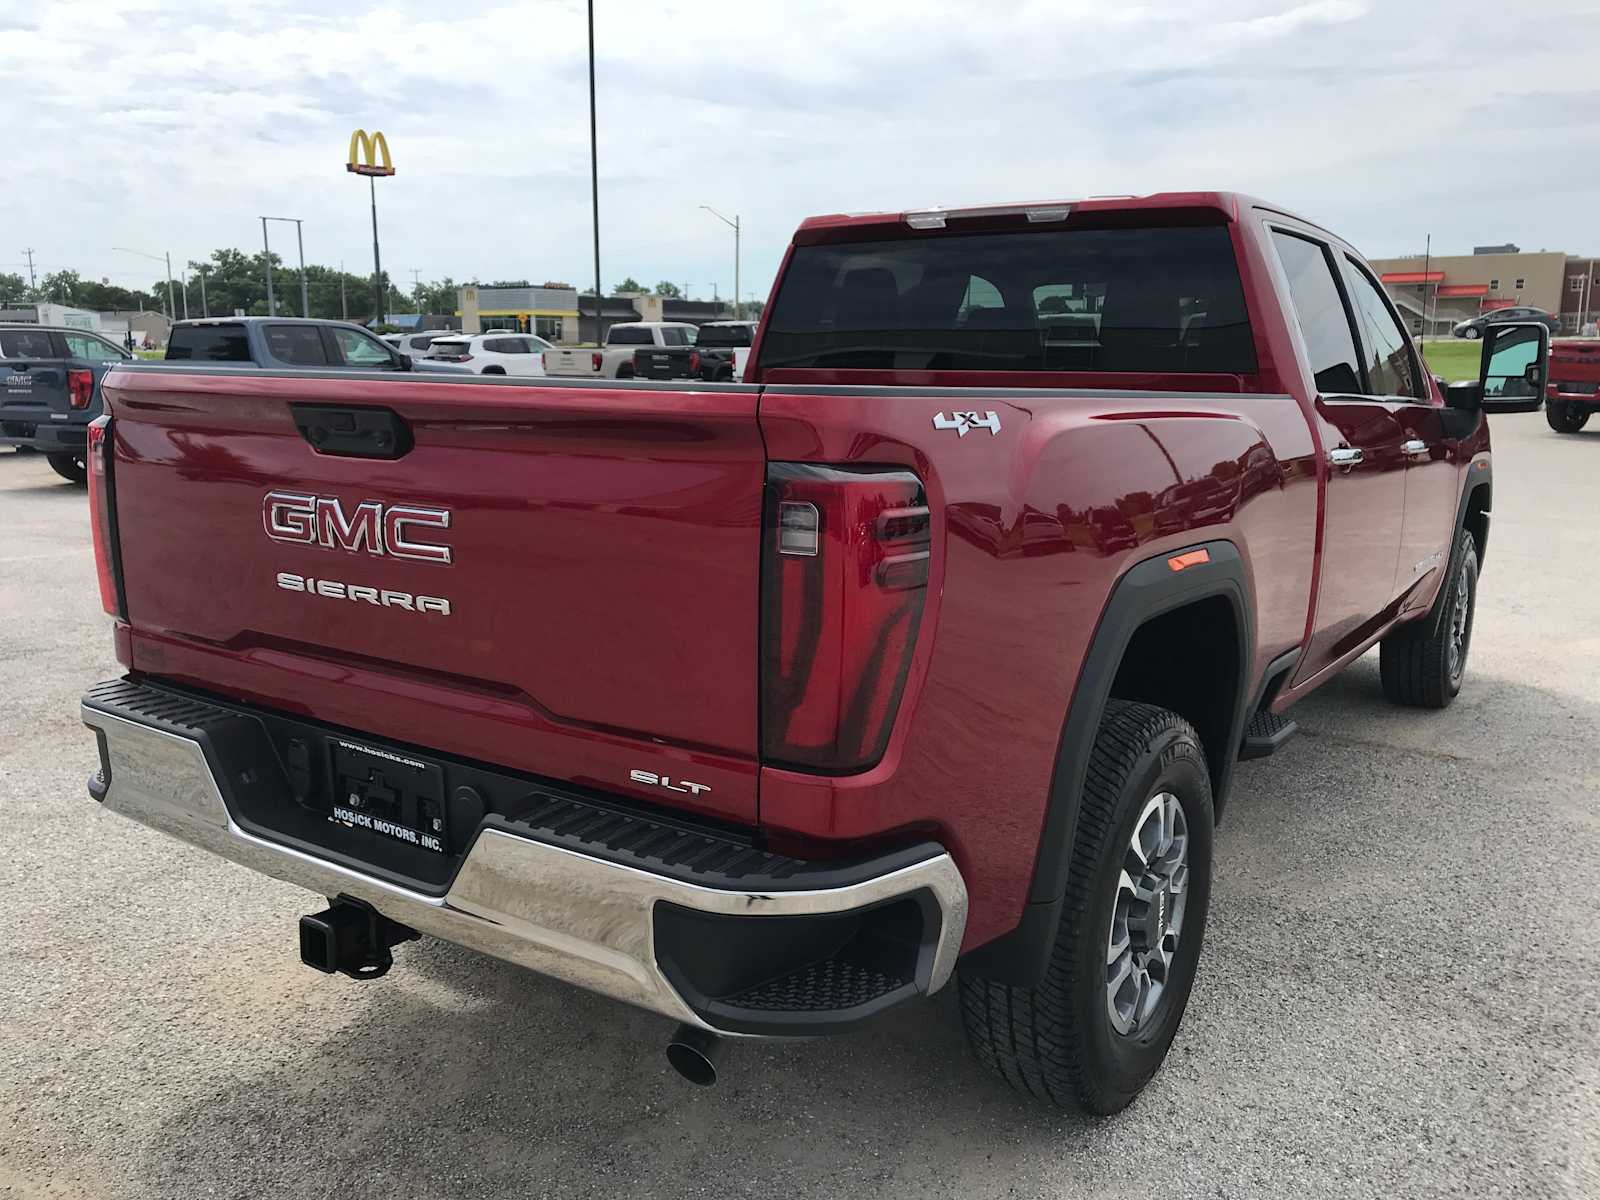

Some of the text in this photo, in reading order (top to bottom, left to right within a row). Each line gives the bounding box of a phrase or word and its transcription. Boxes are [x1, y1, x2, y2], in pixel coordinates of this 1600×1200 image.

[263, 491, 451, 564] GMC
[276, 572, 450, 615] SIERRA
[339, 741, 425, 768] www.hosicks.com
[630, 769, 711, 795] SLT
[333, 807, 442, 852] HOSICK MOTORS, INC.
